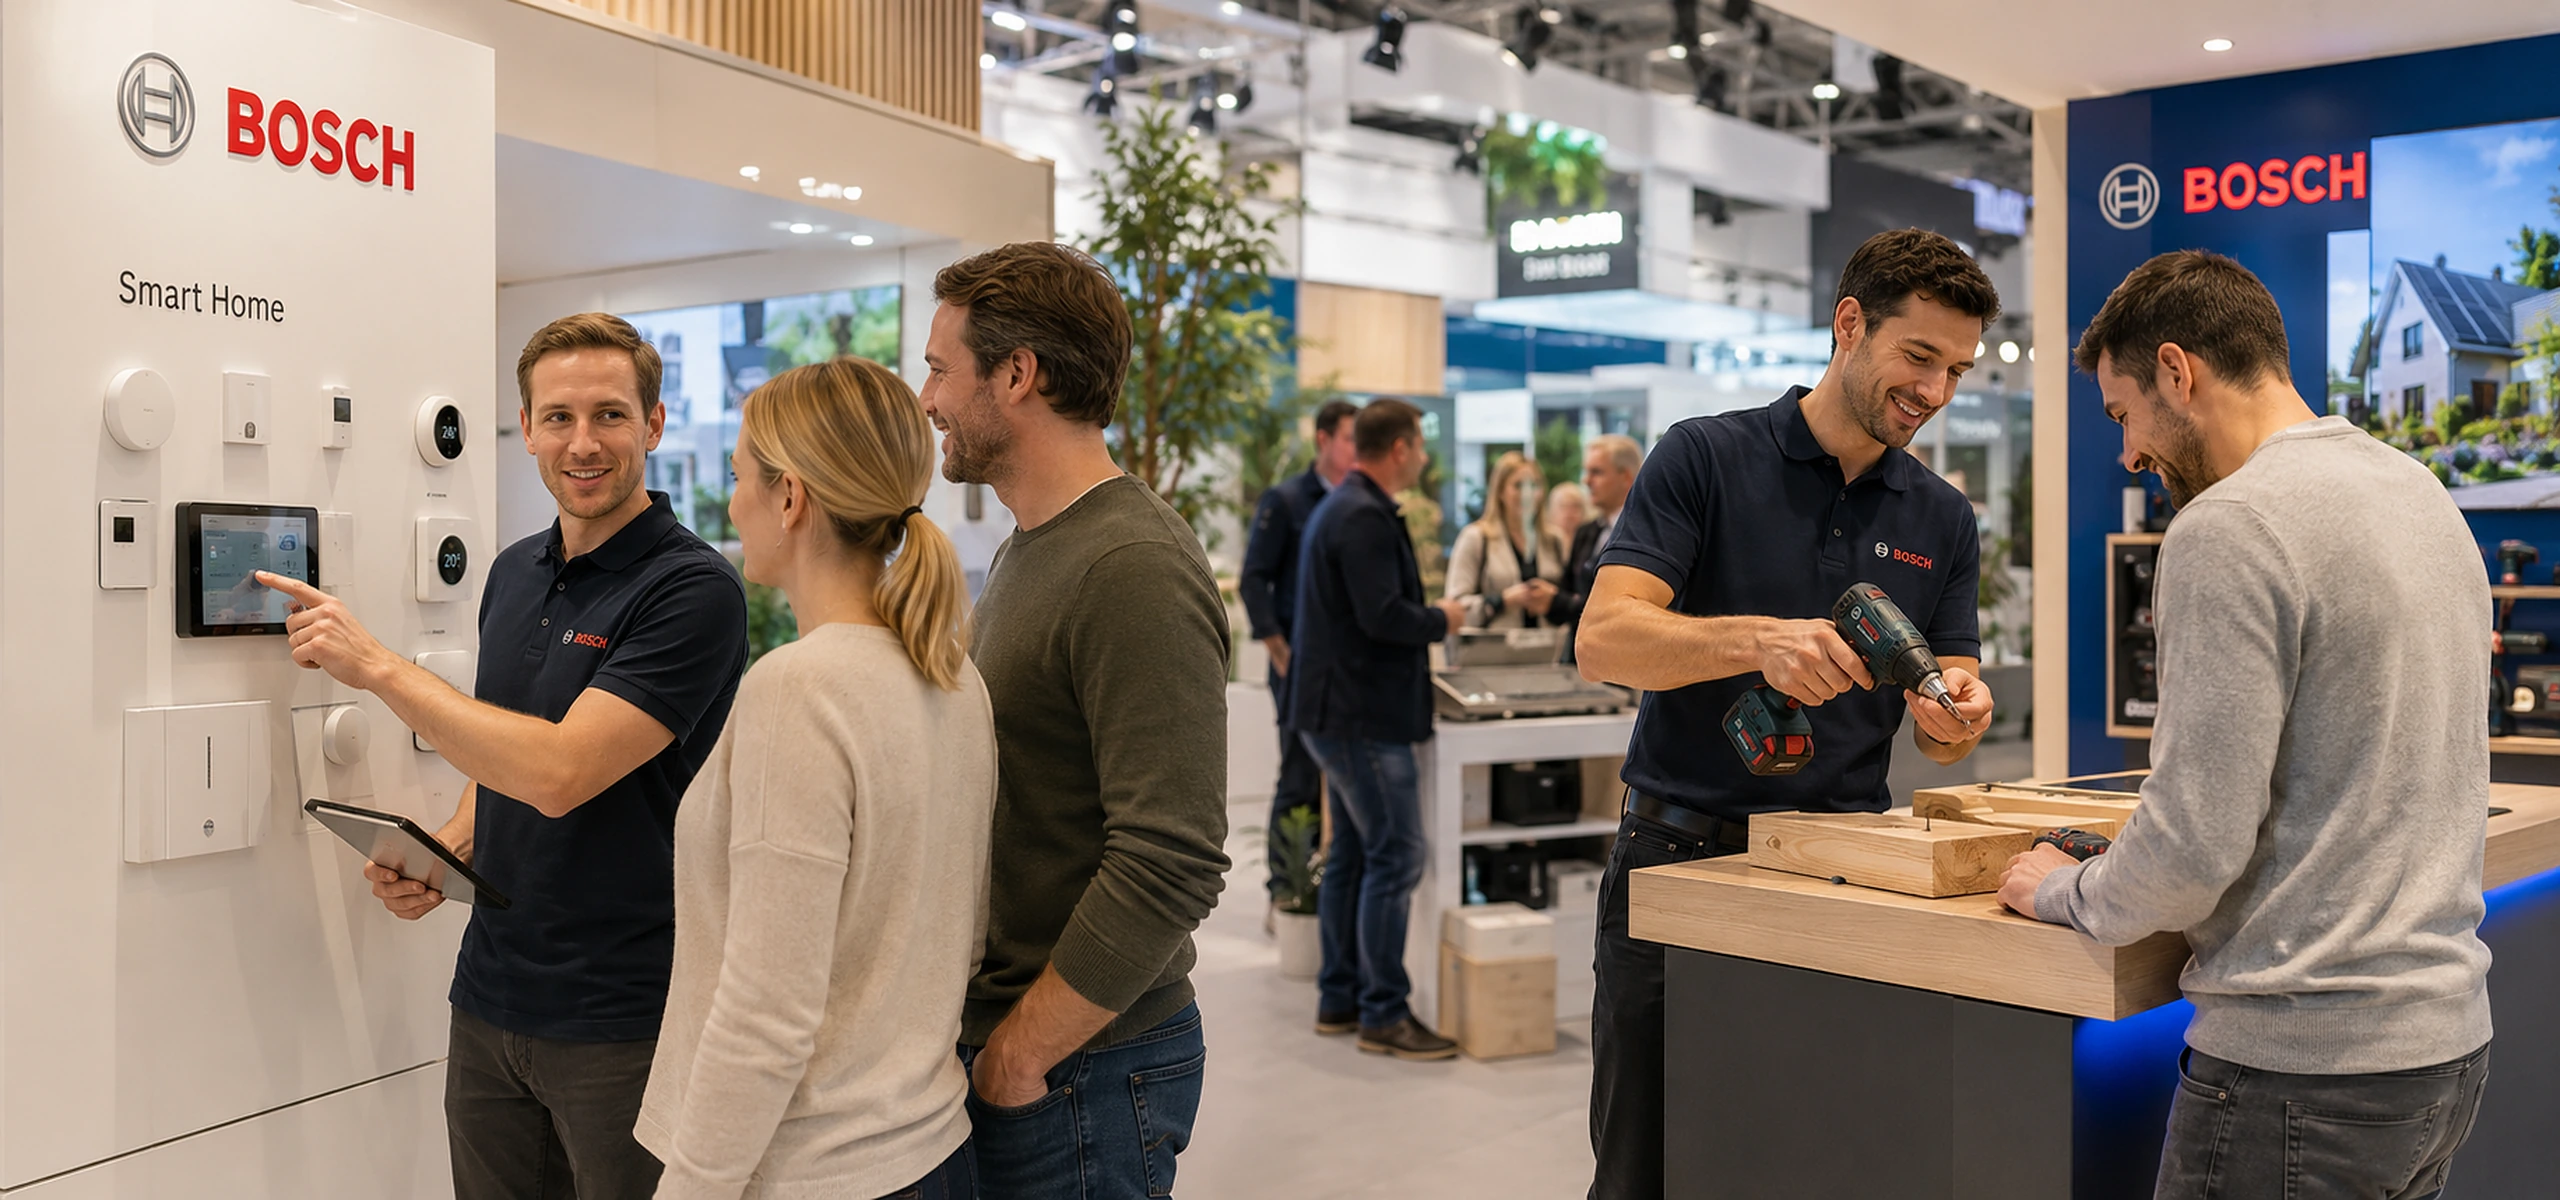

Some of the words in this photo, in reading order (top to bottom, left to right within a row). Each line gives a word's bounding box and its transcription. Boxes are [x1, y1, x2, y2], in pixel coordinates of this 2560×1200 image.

[227, 87, 415, 191] BOSCH
[2183, 151, 2366, 214] BOSCH
[118, 270, 202, 313] Smart
[211, 283, 285, 324] Home
[1893, 548, 1933, 570] BOSCH
[573, 632, 609, 649] BOSCH
